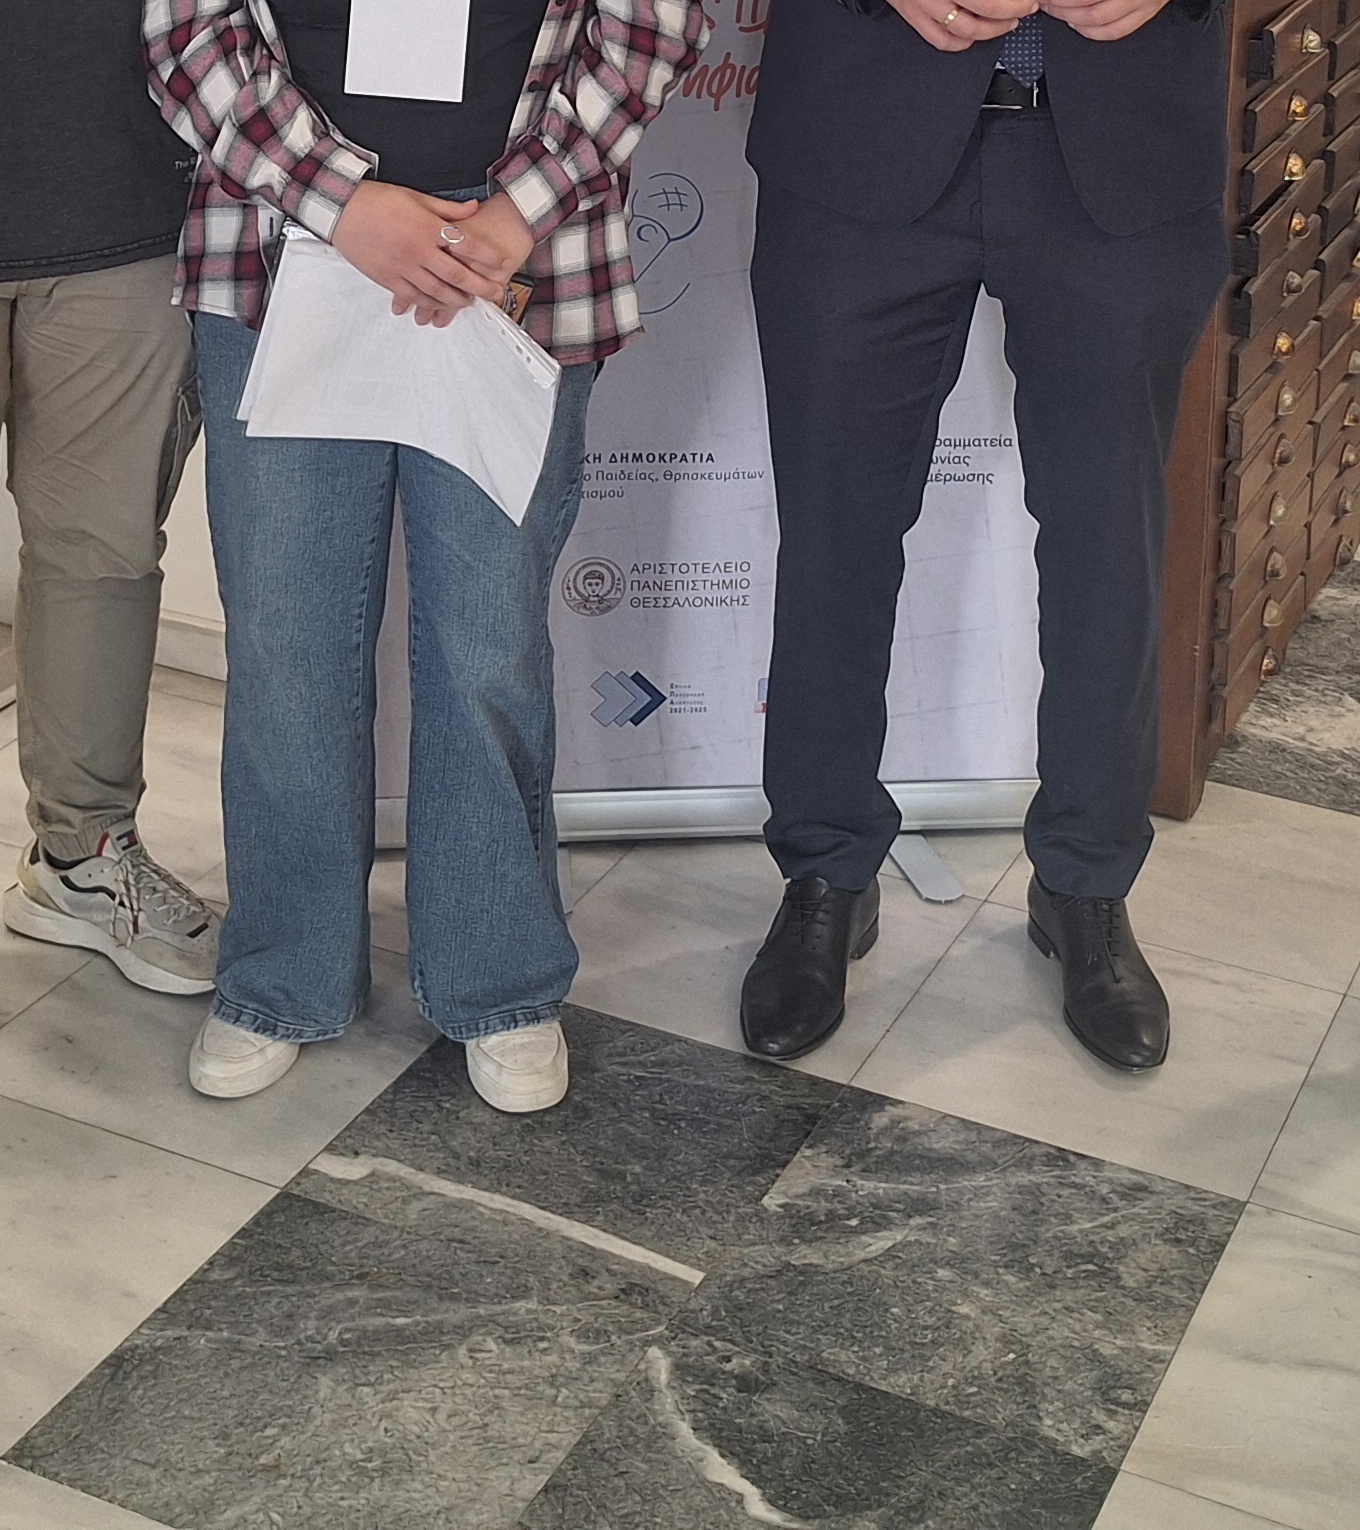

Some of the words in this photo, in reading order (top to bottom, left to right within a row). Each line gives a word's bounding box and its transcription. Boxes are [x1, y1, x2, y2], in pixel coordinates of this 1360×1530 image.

[608, 452, 716, 464] ΔΗΜΟΚΡΑΤΙΑ
[595, 467, 659, 483] Παιδείας,
[663, 467, 765, 483] Θρησκευμάτων
[629, 560, 751, 575] ΑΡΙΣΤΟΤΕΛΕΙΟ
[629, 577, 751, 592] ΠΑΝΕΠΙΣΤΗΜΙΟ
[629, 594, 750, 609] ΘΕΣΣΑΛΟΝΙΚΗΣ
